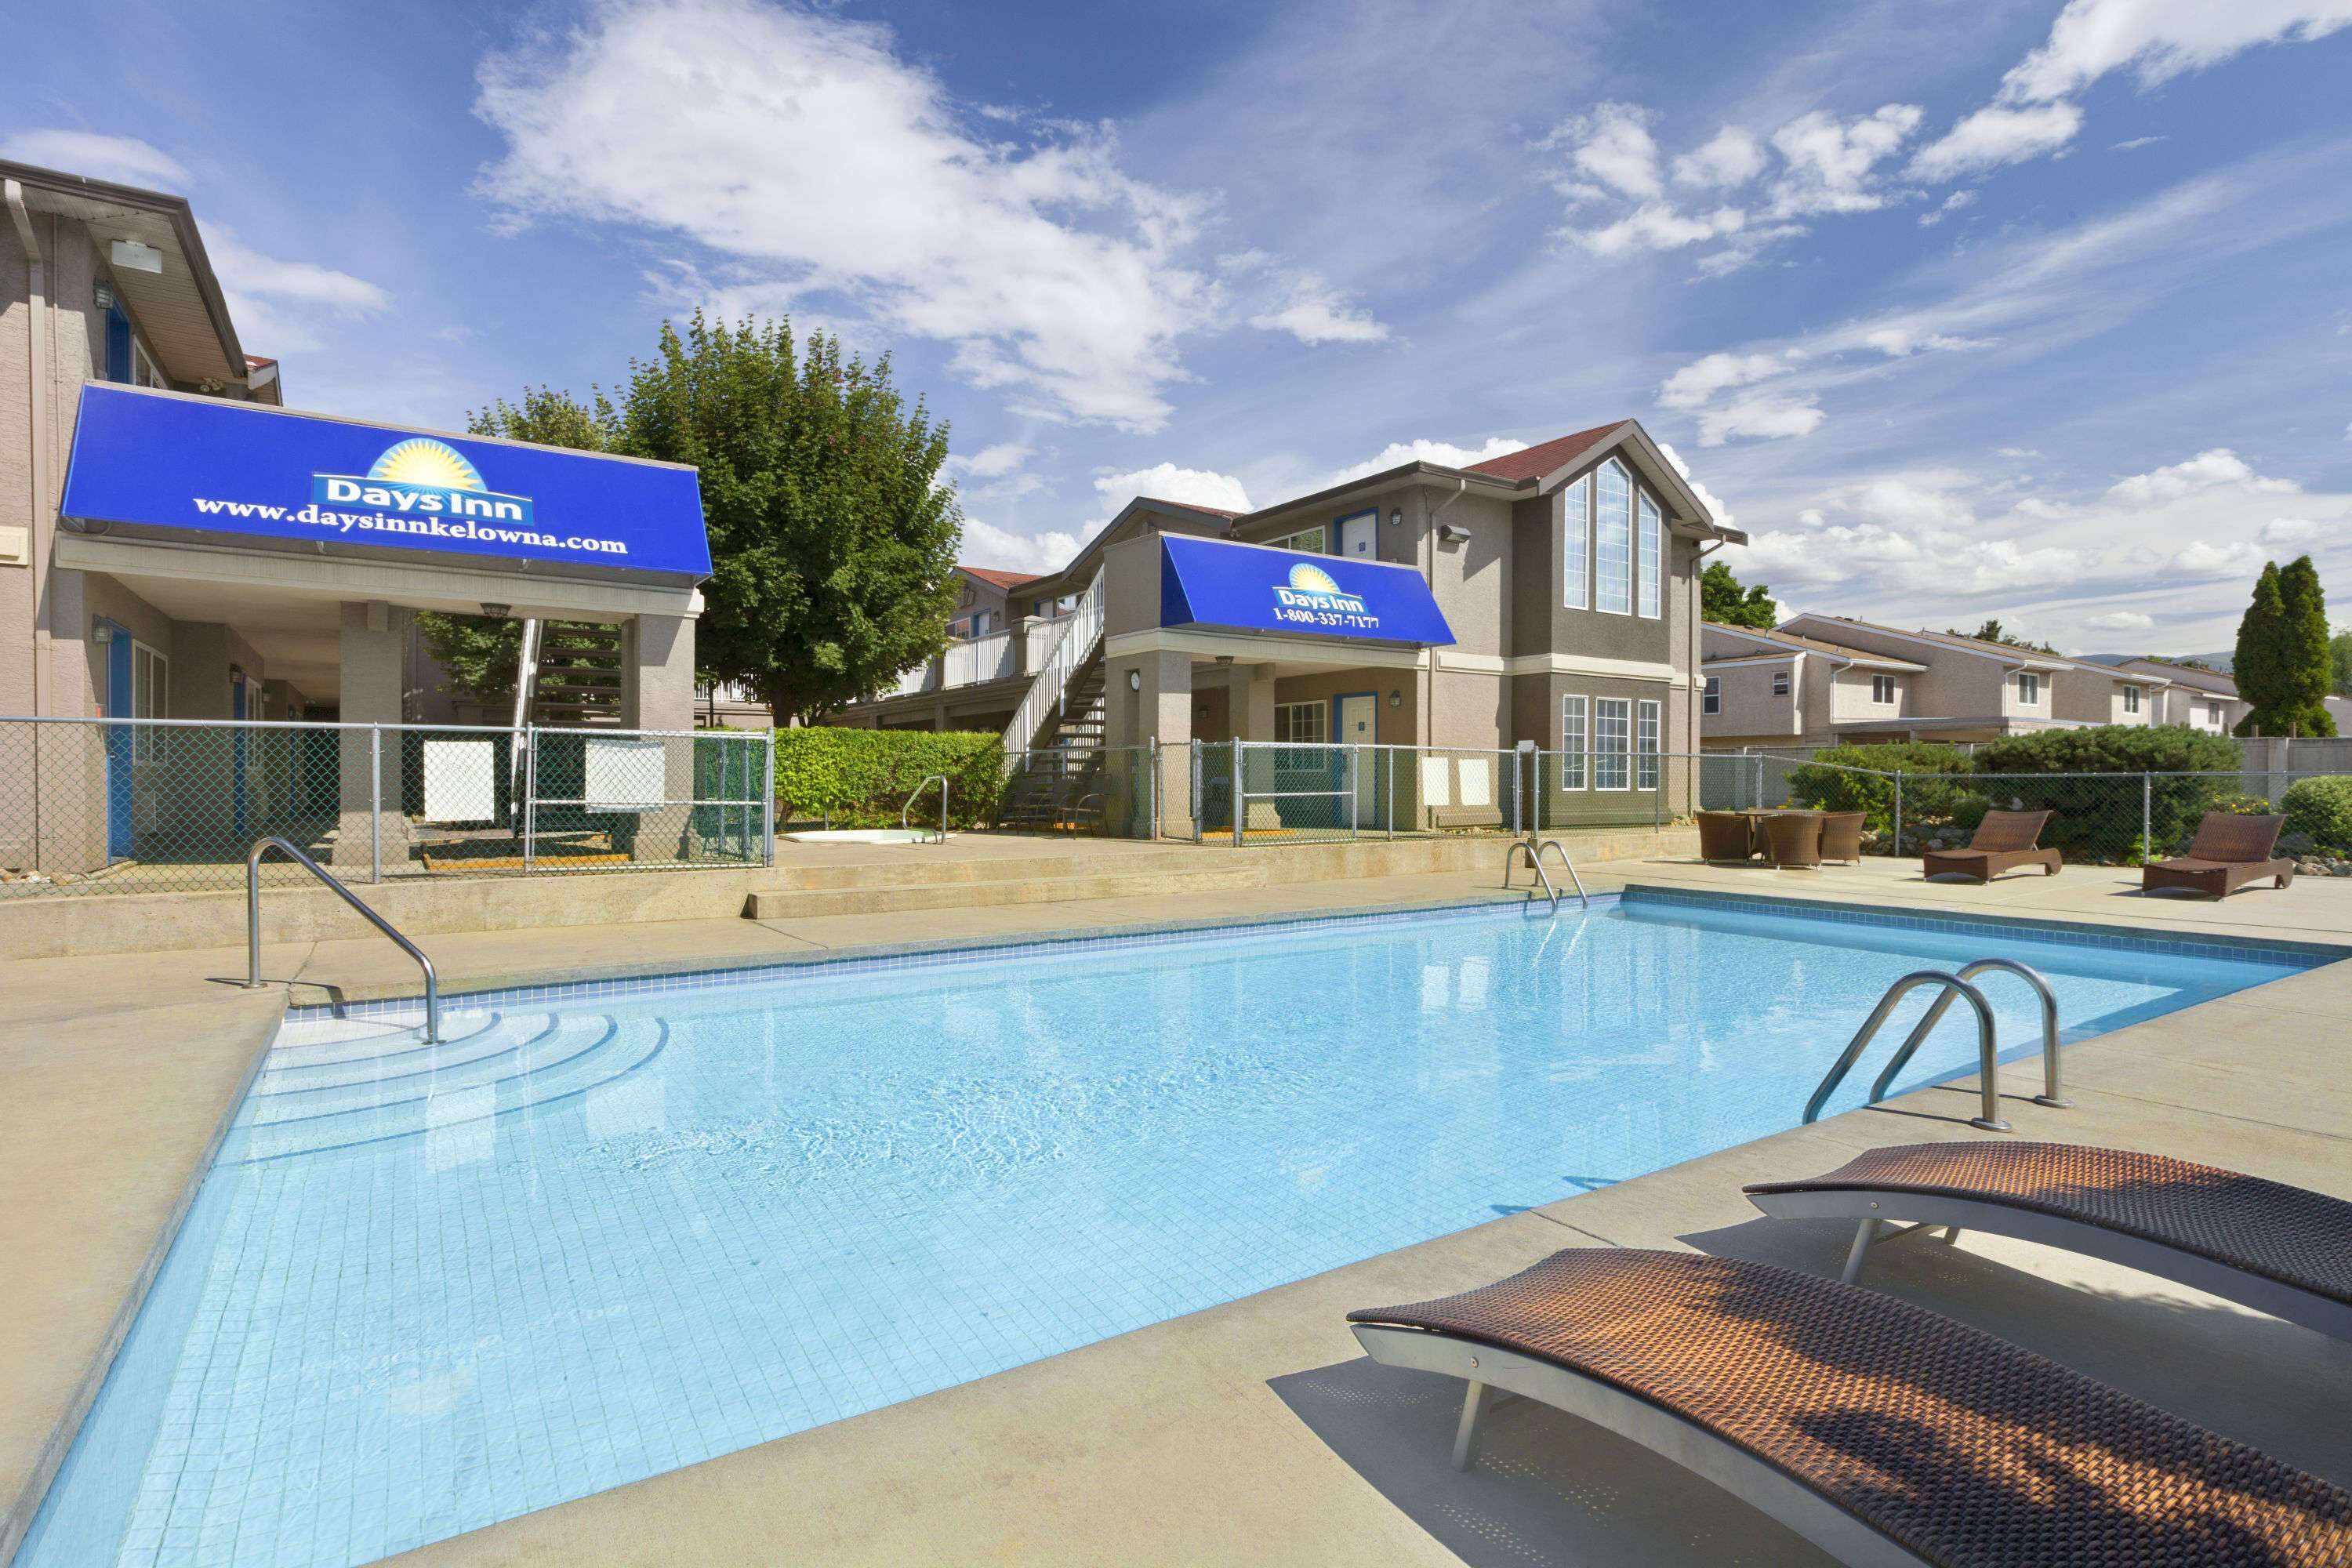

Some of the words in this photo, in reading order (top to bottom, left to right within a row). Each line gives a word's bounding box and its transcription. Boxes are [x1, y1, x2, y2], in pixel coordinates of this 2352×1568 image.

[327, 478, 443, 511] Days
[450, 492, 522, 521] Inn
[193, 498, 628, 554] www.daysinnkelowna.com
[1278, 590, 1330, 610] Days
[1329, 595, 1364, 613] Inn
[1273, 608, 1379, 629] 1-800-337-7177
